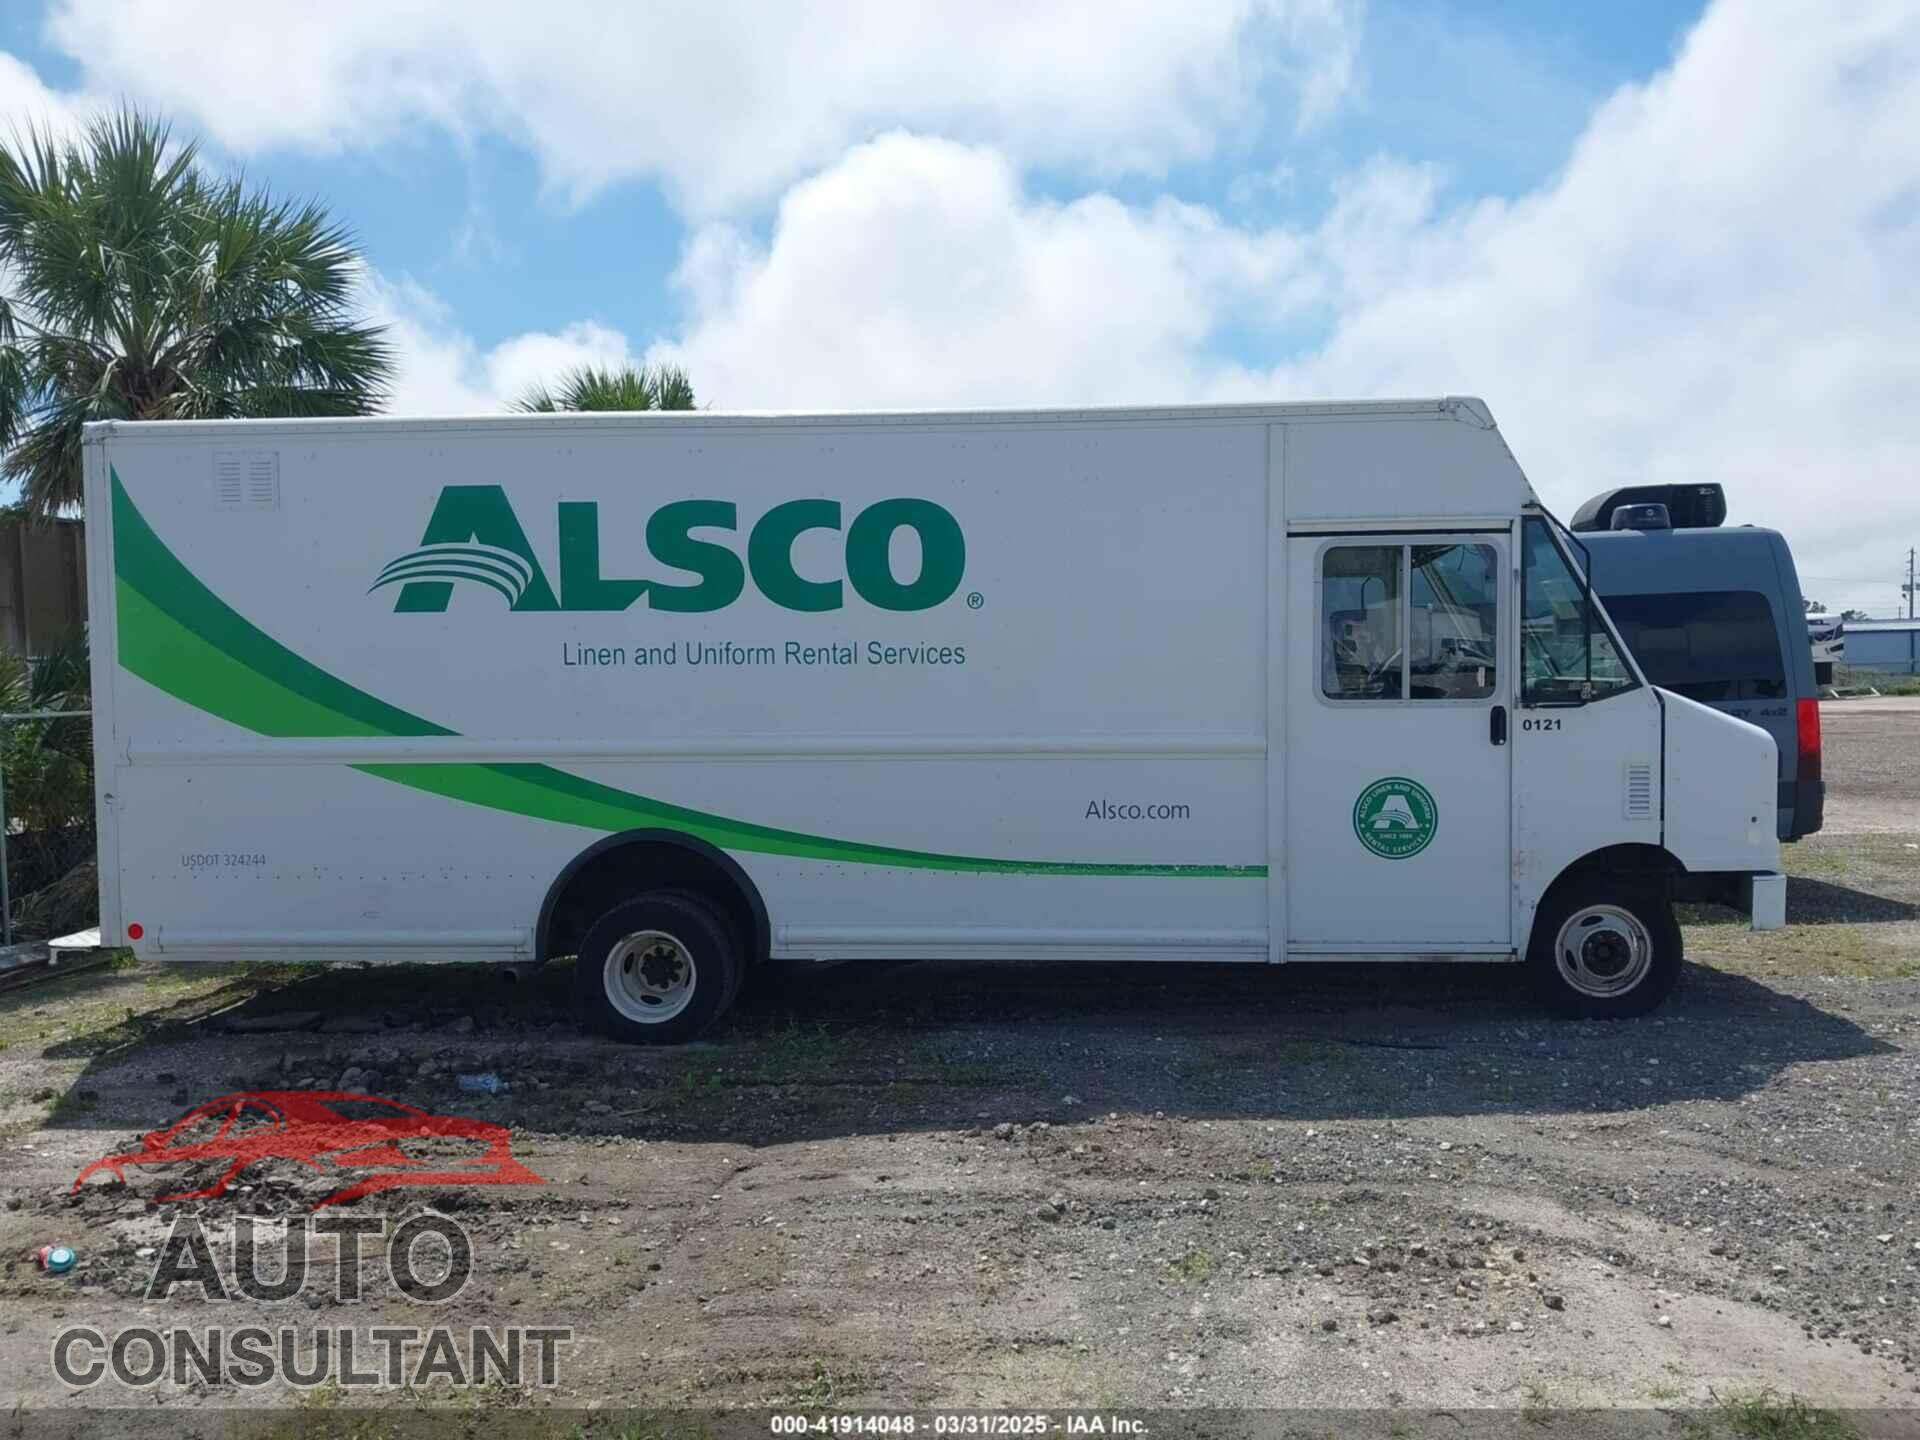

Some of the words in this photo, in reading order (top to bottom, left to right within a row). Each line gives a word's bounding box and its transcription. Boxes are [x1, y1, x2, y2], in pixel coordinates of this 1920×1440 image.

[367, 485, 966, 613] ALSCO
[563, 641, 625, 666] Linen
[634, 641, 676, 666] and
[686, 641, 775, 666] Uniform
[785, 641, 858, 665] Rental
[867, 640, 966, 665] Services
[1522, 718, 1561, 731] 0121
[1394, 784, 1411, 793] AND
[1085, 799, 1190, 820] Alsco.com
[181, 854, 219, 867] USDOT
[223, 854, 266, 866] 324244
